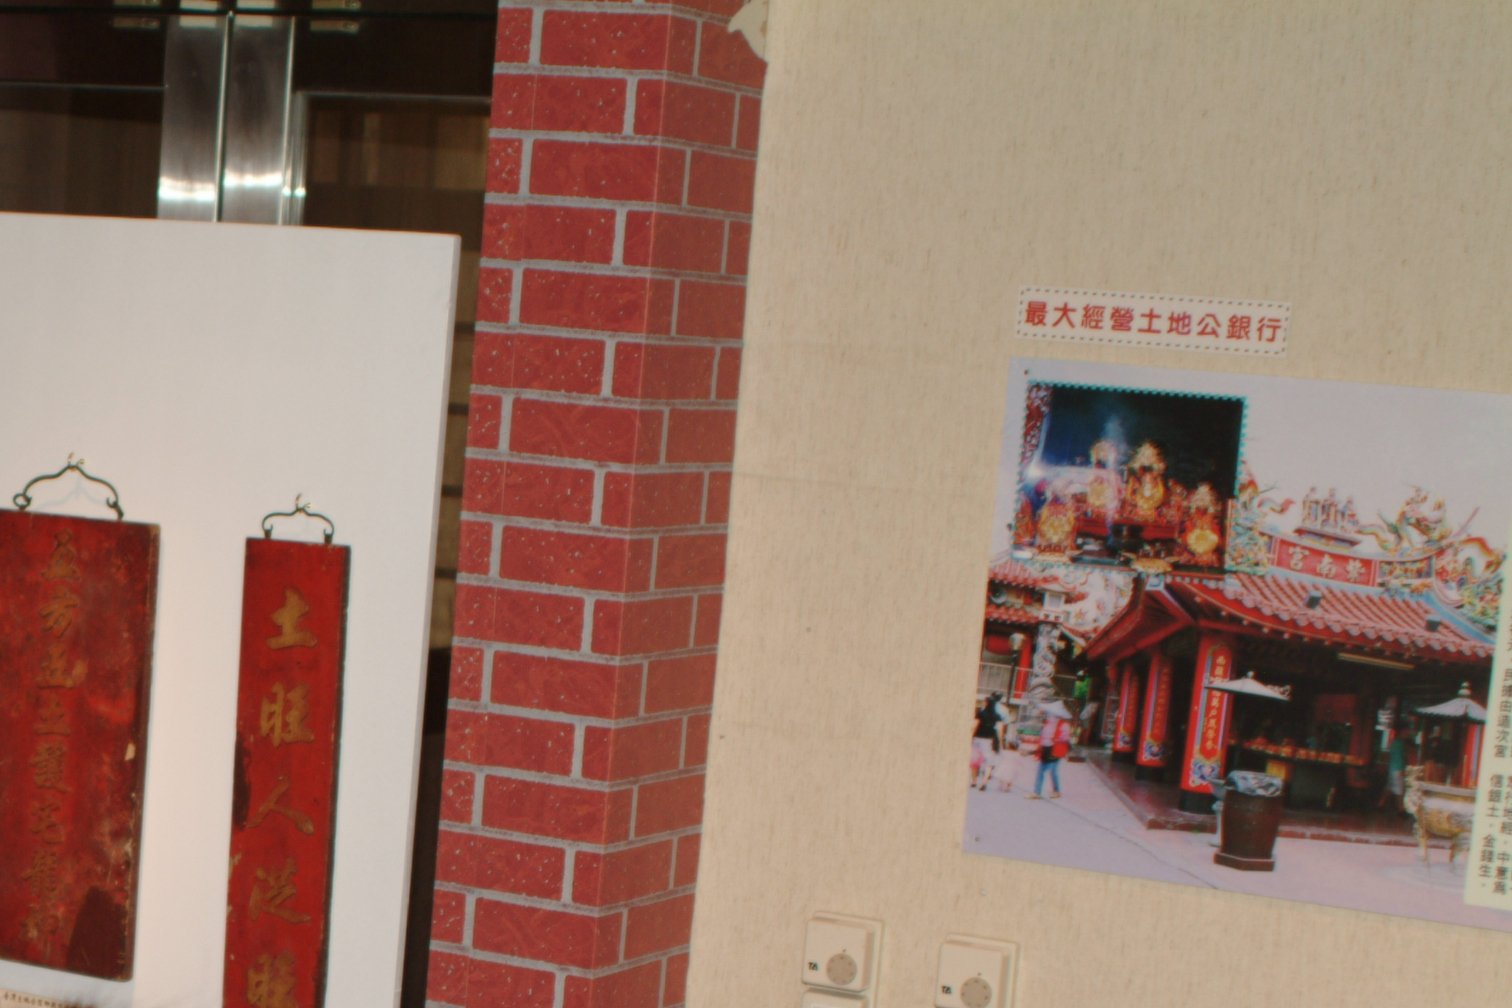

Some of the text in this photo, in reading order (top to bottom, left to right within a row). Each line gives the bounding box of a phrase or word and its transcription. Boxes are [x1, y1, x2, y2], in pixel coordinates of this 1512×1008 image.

[1024, 301, 1283, 343] 最大經營土地公銀行
